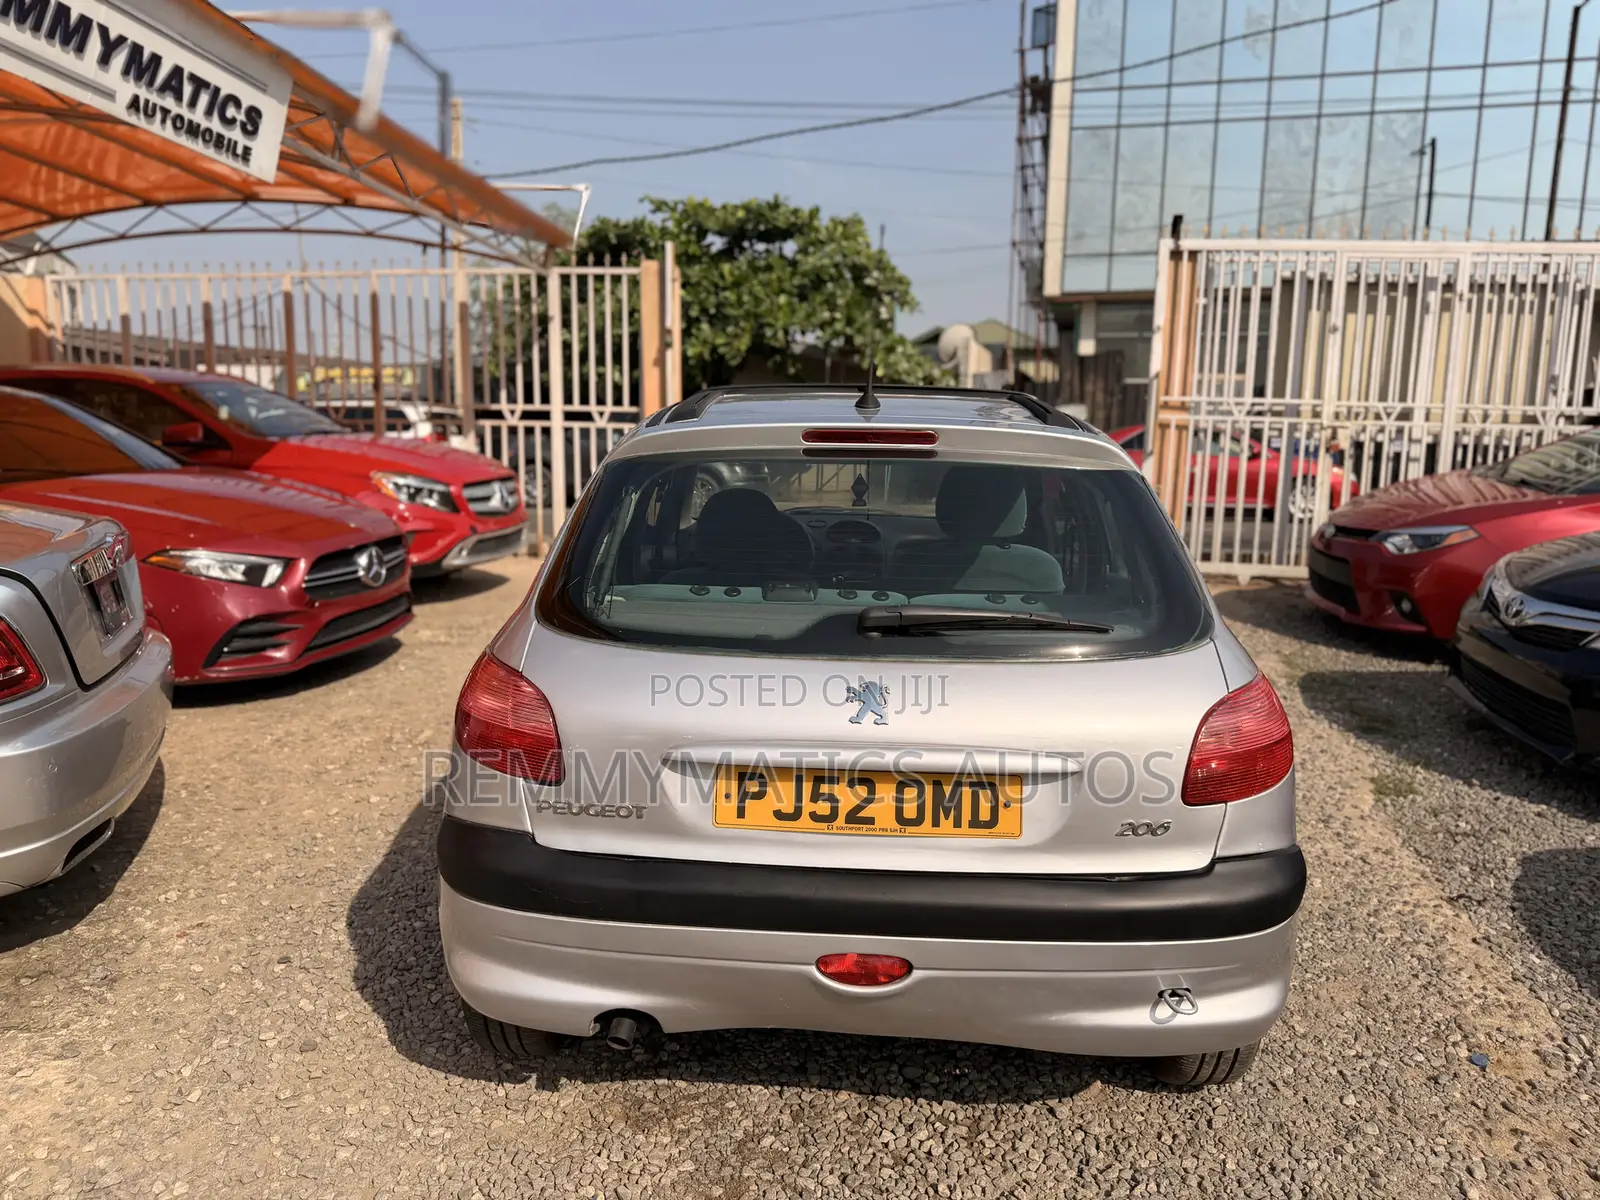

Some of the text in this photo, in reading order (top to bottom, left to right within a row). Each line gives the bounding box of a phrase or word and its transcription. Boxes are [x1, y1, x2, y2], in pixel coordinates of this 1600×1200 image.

[125, 93, 253, 167] AUTOMOBILE
[536, 800, 648, 820] PEUGEOT
[736, 771, 999, 829] PJ52 OMD
[1114, 819, 1173, 838] 206
